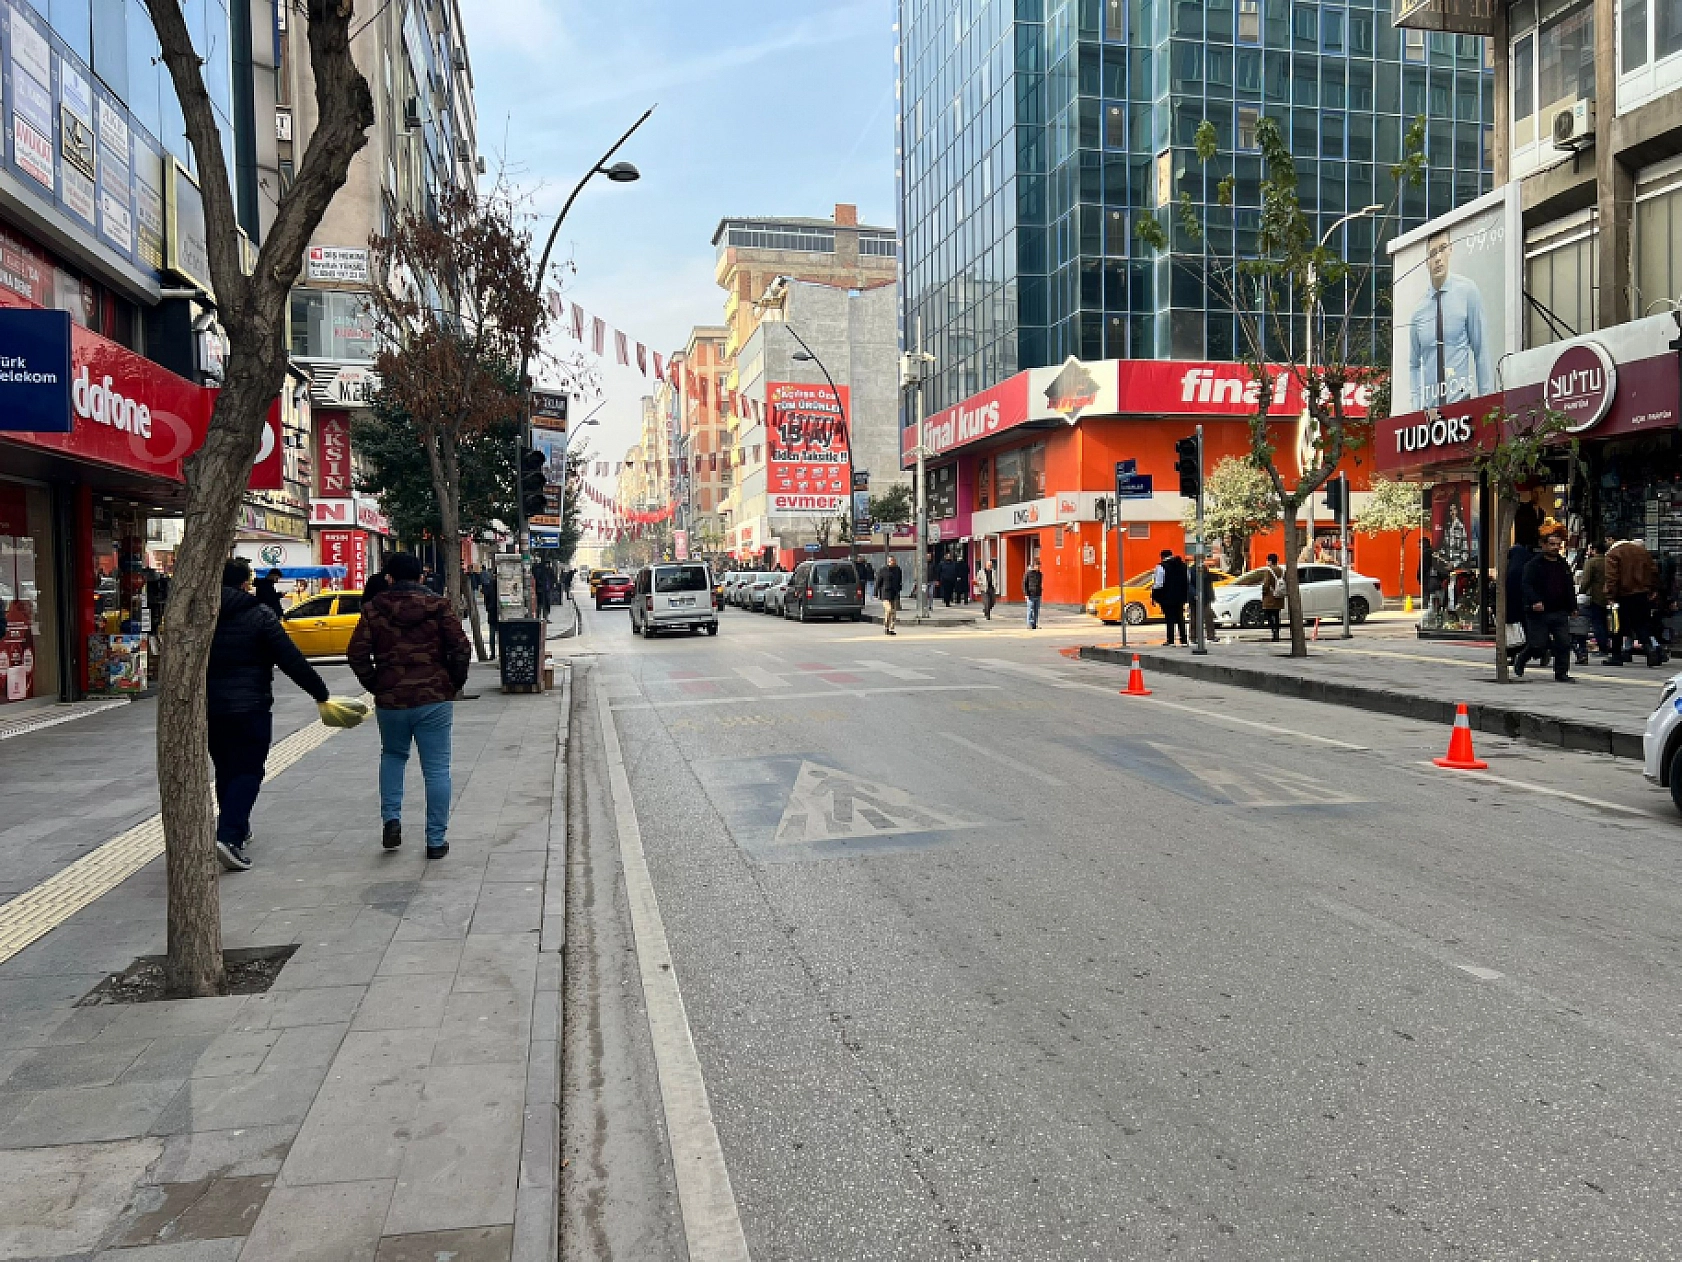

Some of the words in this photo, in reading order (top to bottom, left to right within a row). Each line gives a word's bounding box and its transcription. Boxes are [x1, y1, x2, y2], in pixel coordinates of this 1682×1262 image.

[1181, 367, 1289, 405] final
[1424, 374, 1475, 402] TUDORS
[958, 400, 1000, 442] kurs
[1395, 415, 1473, 454] TUDORS
[310, 503, 345, 522] N
[775, 495, 837, 509] evmer
